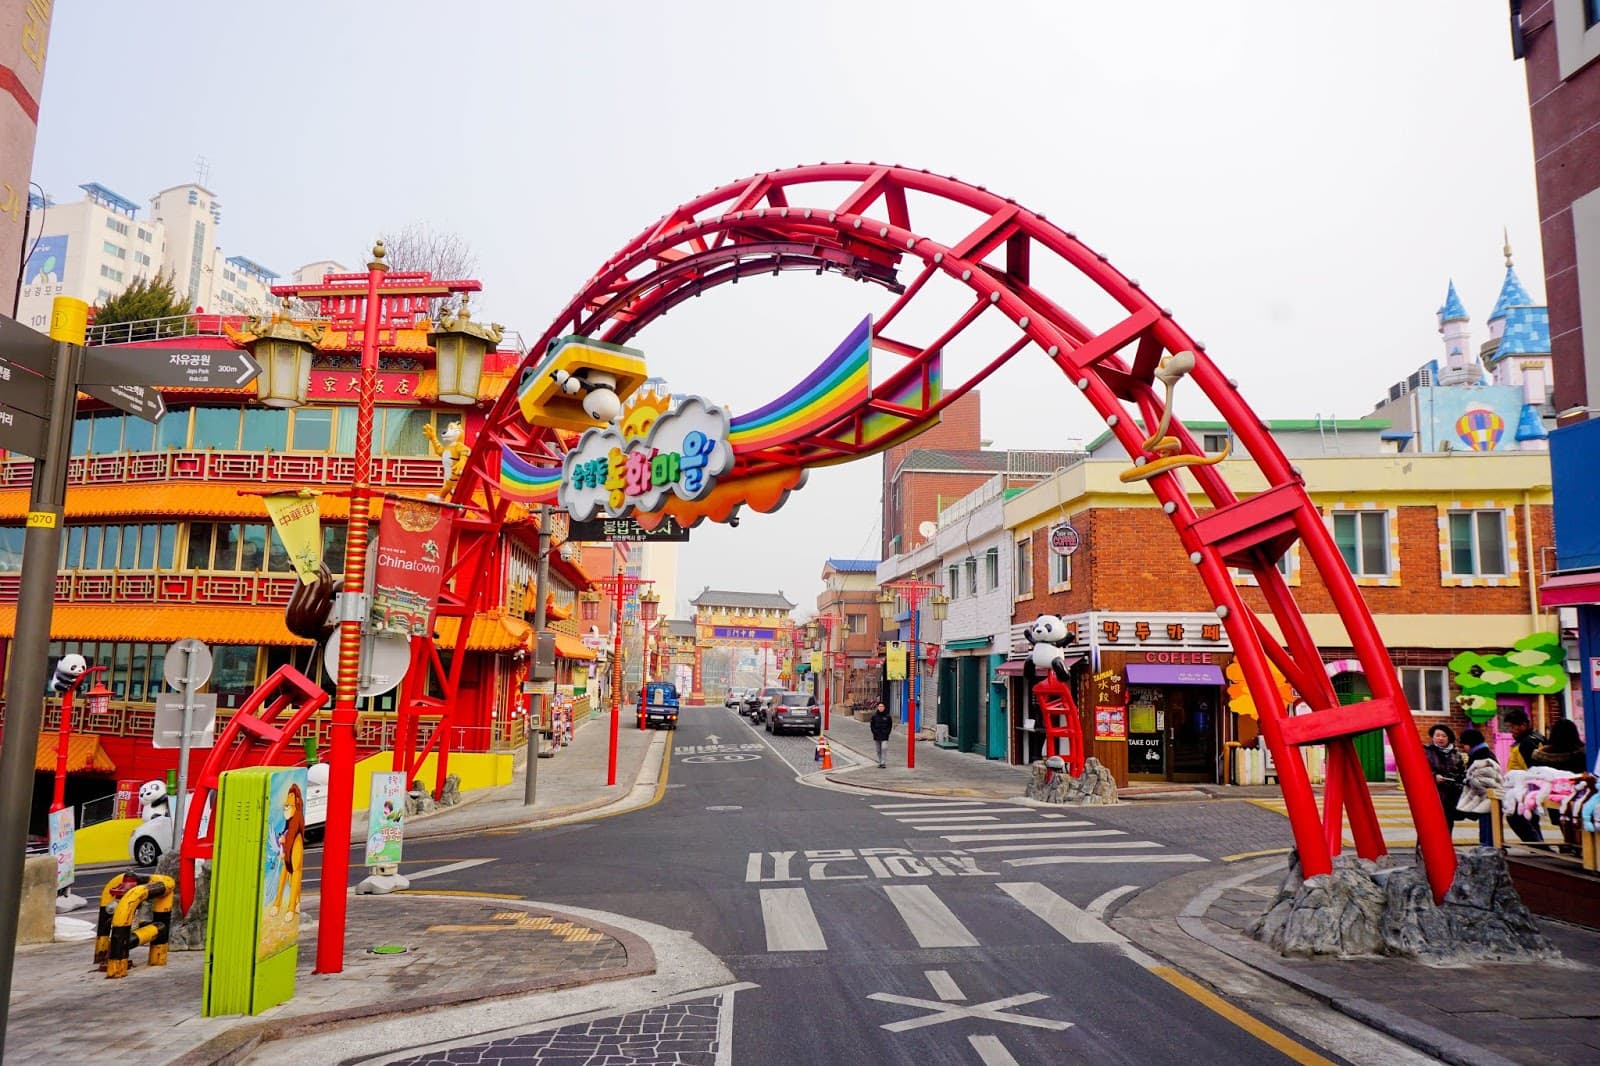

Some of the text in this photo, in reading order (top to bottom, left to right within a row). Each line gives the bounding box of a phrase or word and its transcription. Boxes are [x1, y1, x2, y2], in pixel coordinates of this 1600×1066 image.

[31, 315, 47, 326] 101
[169, 354, 211, 366] 자유공원
[0, 366, 11, 381] 폼
[217, 364, 238, 373] 300m
[571, 431, 716, 509] 송월동 동화마을
[378, 553, 440, 574] Chinatown
[1102, 620, 1221, 642] 만두카페
[1145, 652, 1212, 664] COFFEE
[1128, 739, 1160, 747] TAKE OUT
[744, 847, 1001, 882] 진입금지
